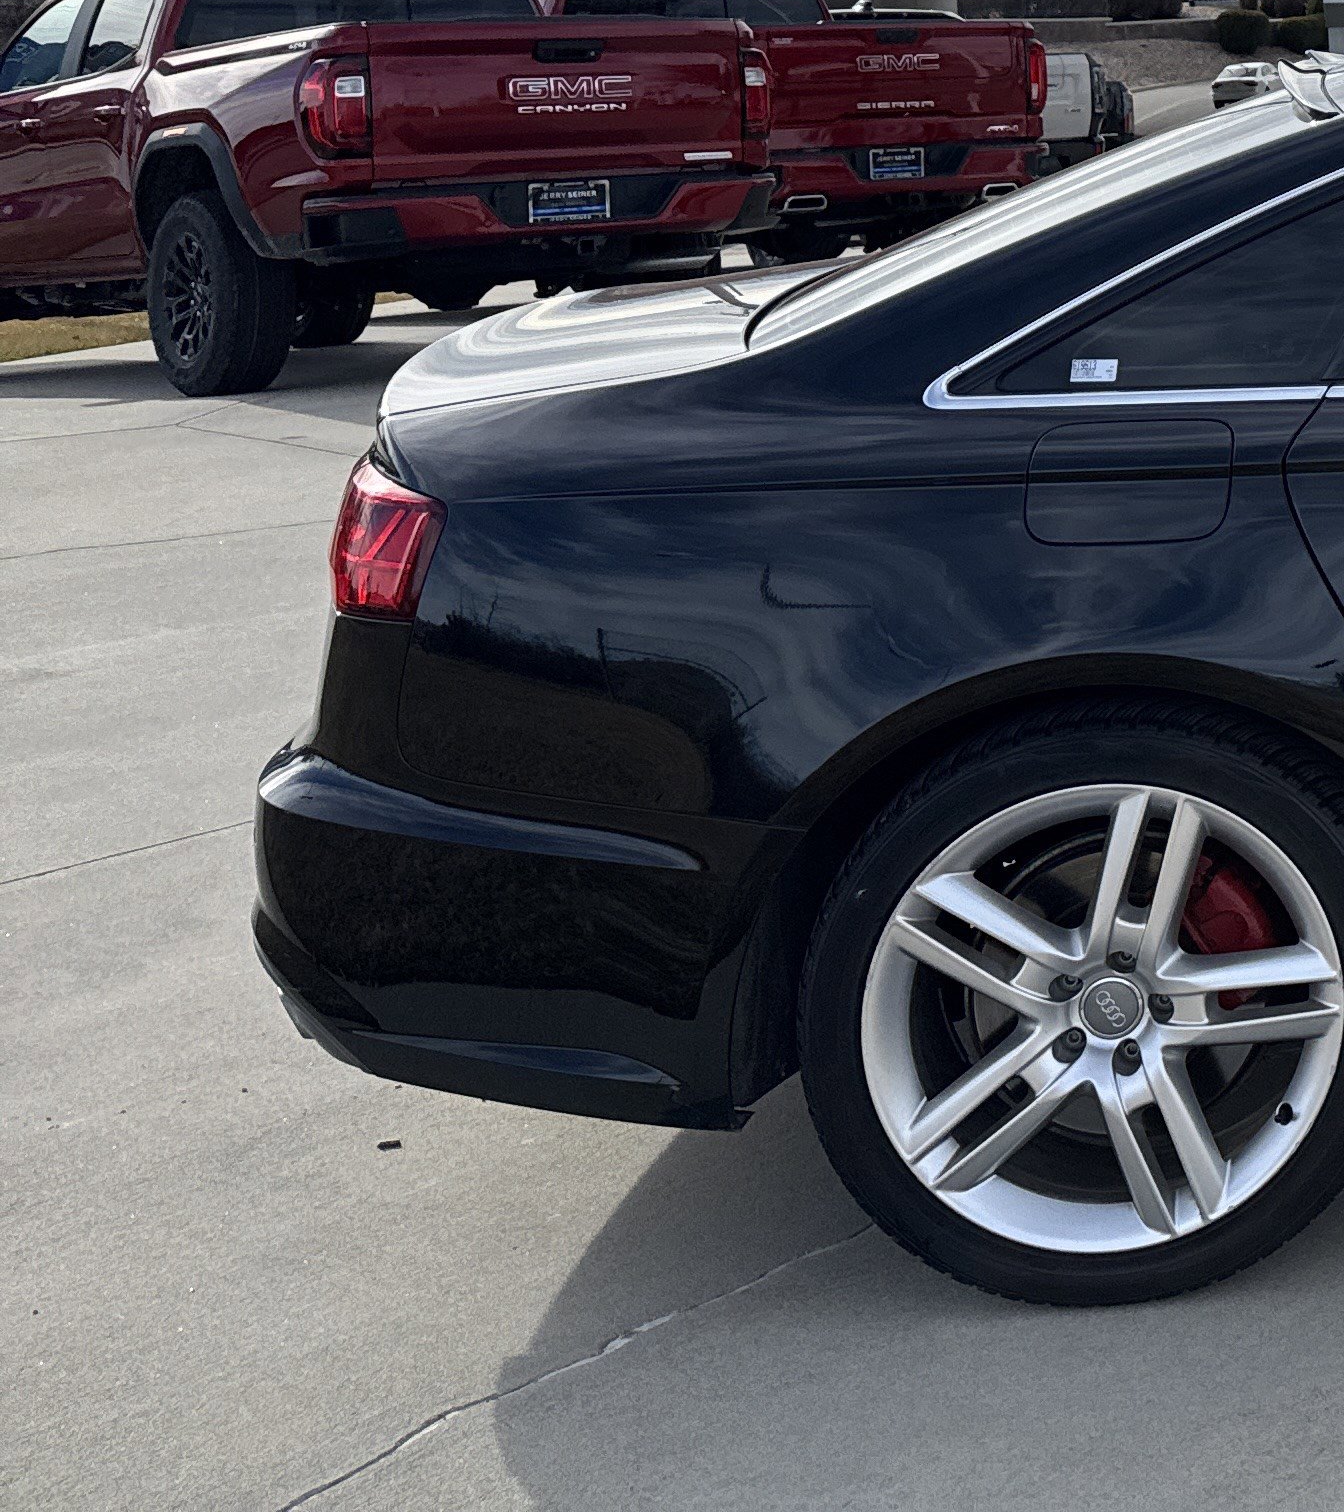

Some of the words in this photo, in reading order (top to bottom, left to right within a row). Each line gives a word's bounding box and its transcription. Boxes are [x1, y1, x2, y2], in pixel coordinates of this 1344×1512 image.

[856, 53, 940, 72] GMC
[508, 75, 633, 100] GMC
[517, 102, 627, 114] CANYON
[856, 100, 935, 110] SIERRA
